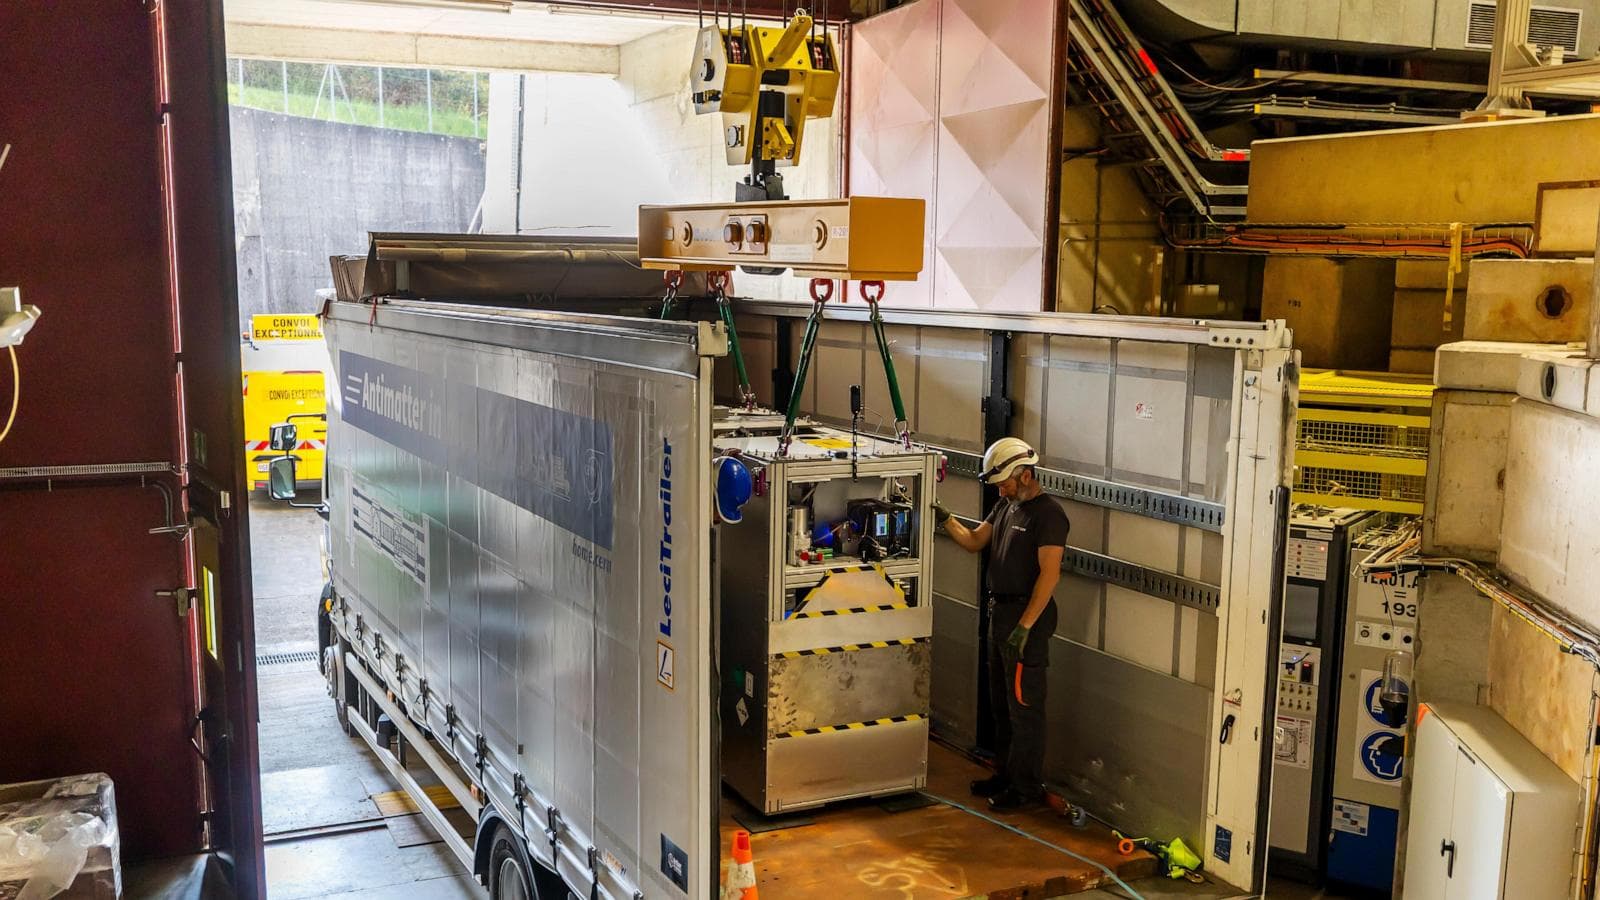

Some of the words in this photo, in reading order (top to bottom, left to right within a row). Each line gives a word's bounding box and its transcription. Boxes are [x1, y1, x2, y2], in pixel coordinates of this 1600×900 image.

[273, 318, 310, 328] CONVOI
[362, 371, 426, 432] Antimatter
[659, 437, 673, 637] LeciTrailer
